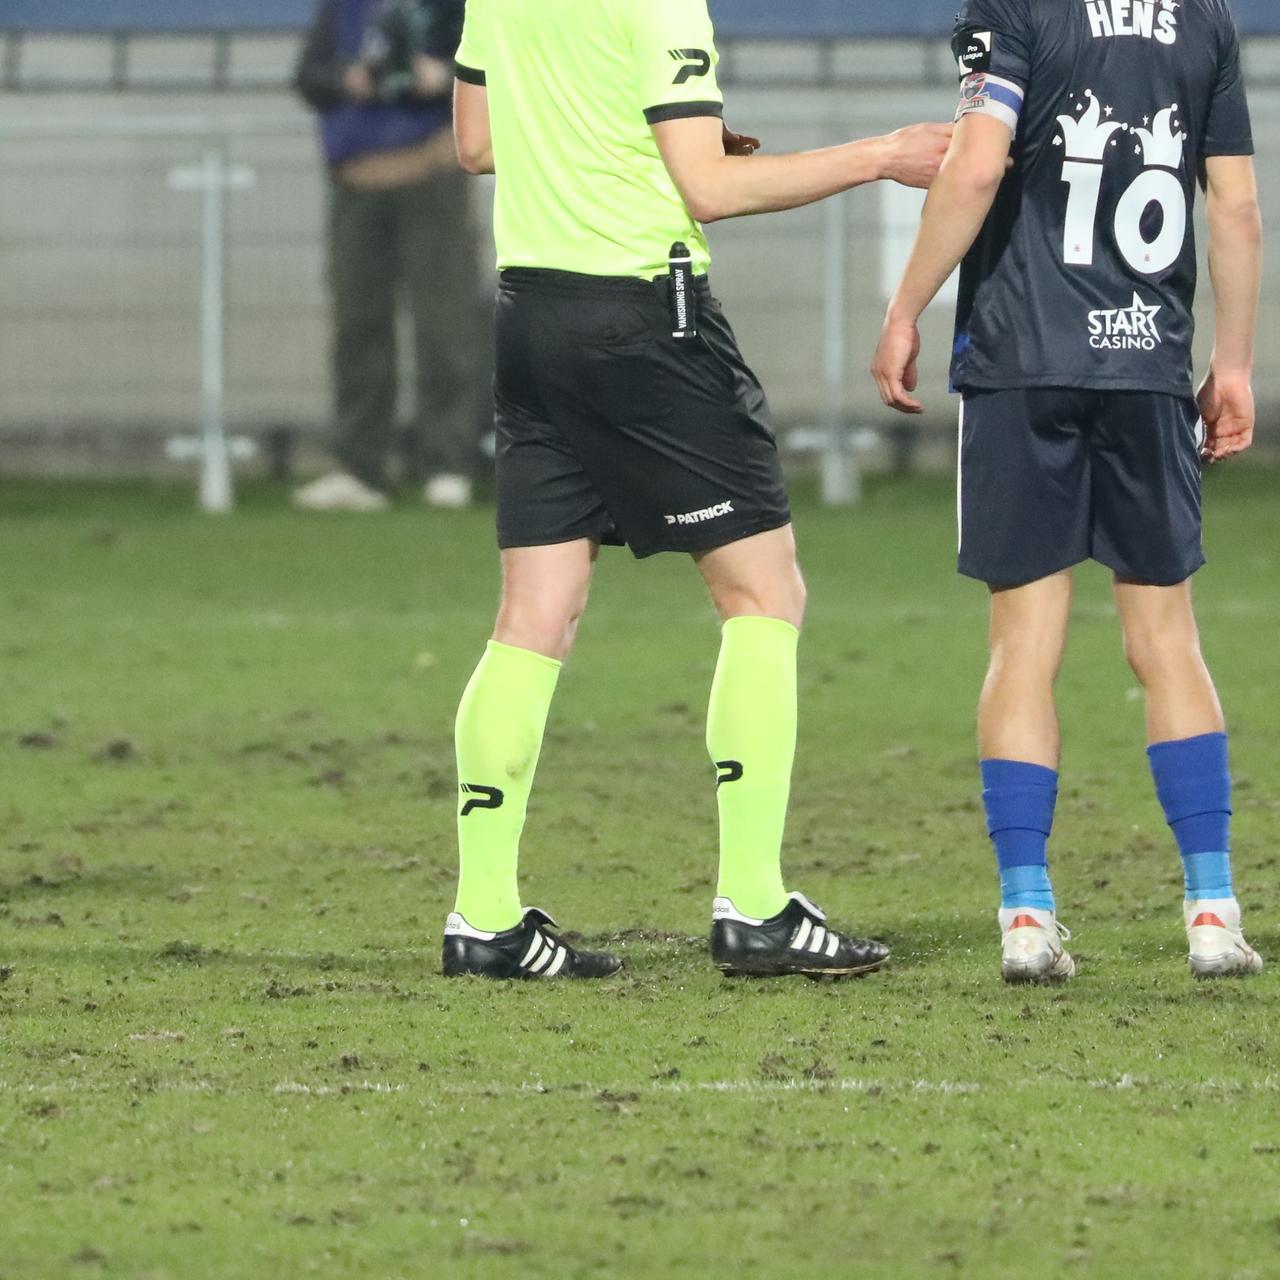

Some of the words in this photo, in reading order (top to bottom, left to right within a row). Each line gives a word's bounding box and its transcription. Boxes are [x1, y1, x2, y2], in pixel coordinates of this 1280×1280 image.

[962, 52, 984, 61] League
[967, 45, 978, 53] Pro
[1061, 160, 1187, 274] 10
[675, 268, 685, 291] SPRAY
[676, 290, 687, 329] VANISHING
[1087, 308, 1151, 337] STAR
[1089, 335, 1155, 351] CASINO
[677, 500, 734, 525] PATRICK
